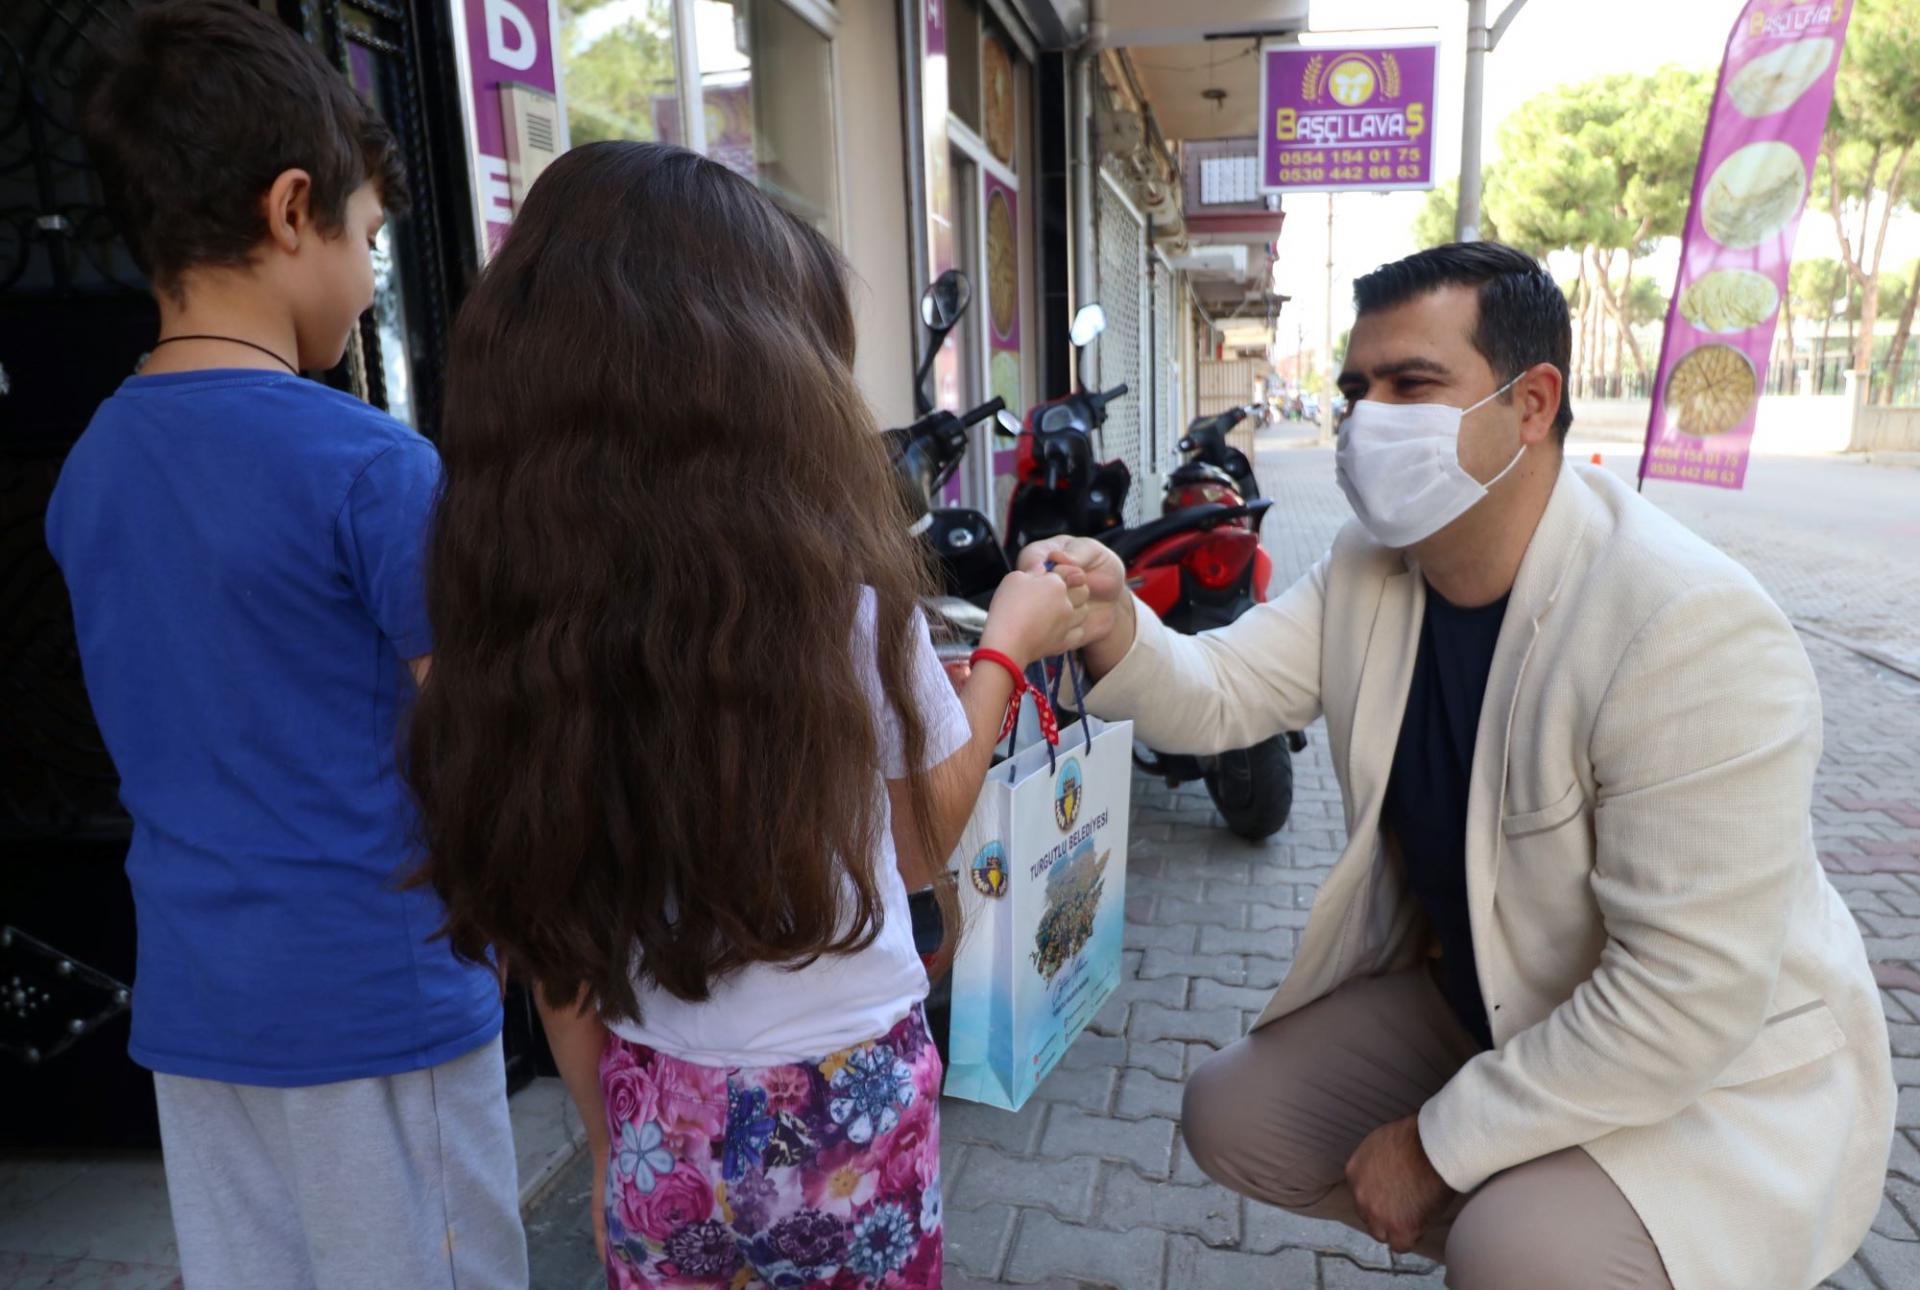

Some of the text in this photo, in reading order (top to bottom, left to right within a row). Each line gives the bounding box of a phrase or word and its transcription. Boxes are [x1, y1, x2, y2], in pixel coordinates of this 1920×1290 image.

[1368, 148, 1391, 163] 01
[1329, 166, 1363, 180] 442
[1030, 806, 1108, 881] TURGUTLU BELEDİYESİ
